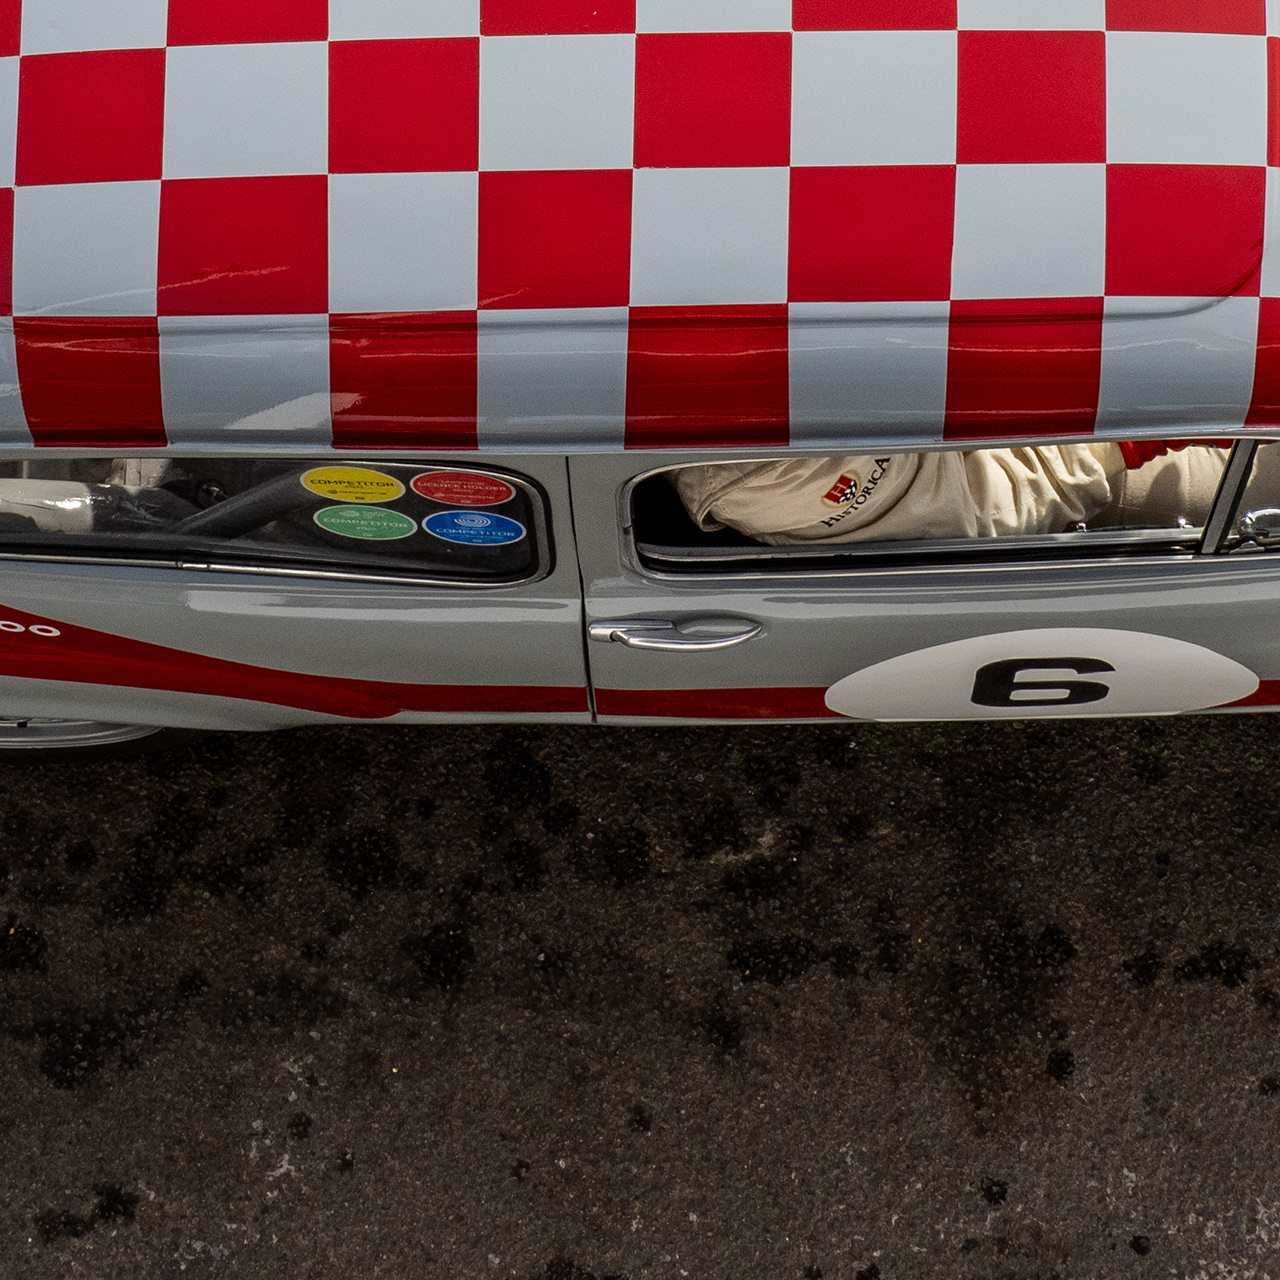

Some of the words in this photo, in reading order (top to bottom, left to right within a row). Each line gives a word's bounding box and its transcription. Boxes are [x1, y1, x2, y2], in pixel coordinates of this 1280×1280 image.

[310, 479, 395, 488] COMPETITOR
[830, 482, 848, 497] H
[435, 527, 515, 537] COMPETITOR
[969, 656, 1117, 708] 6
